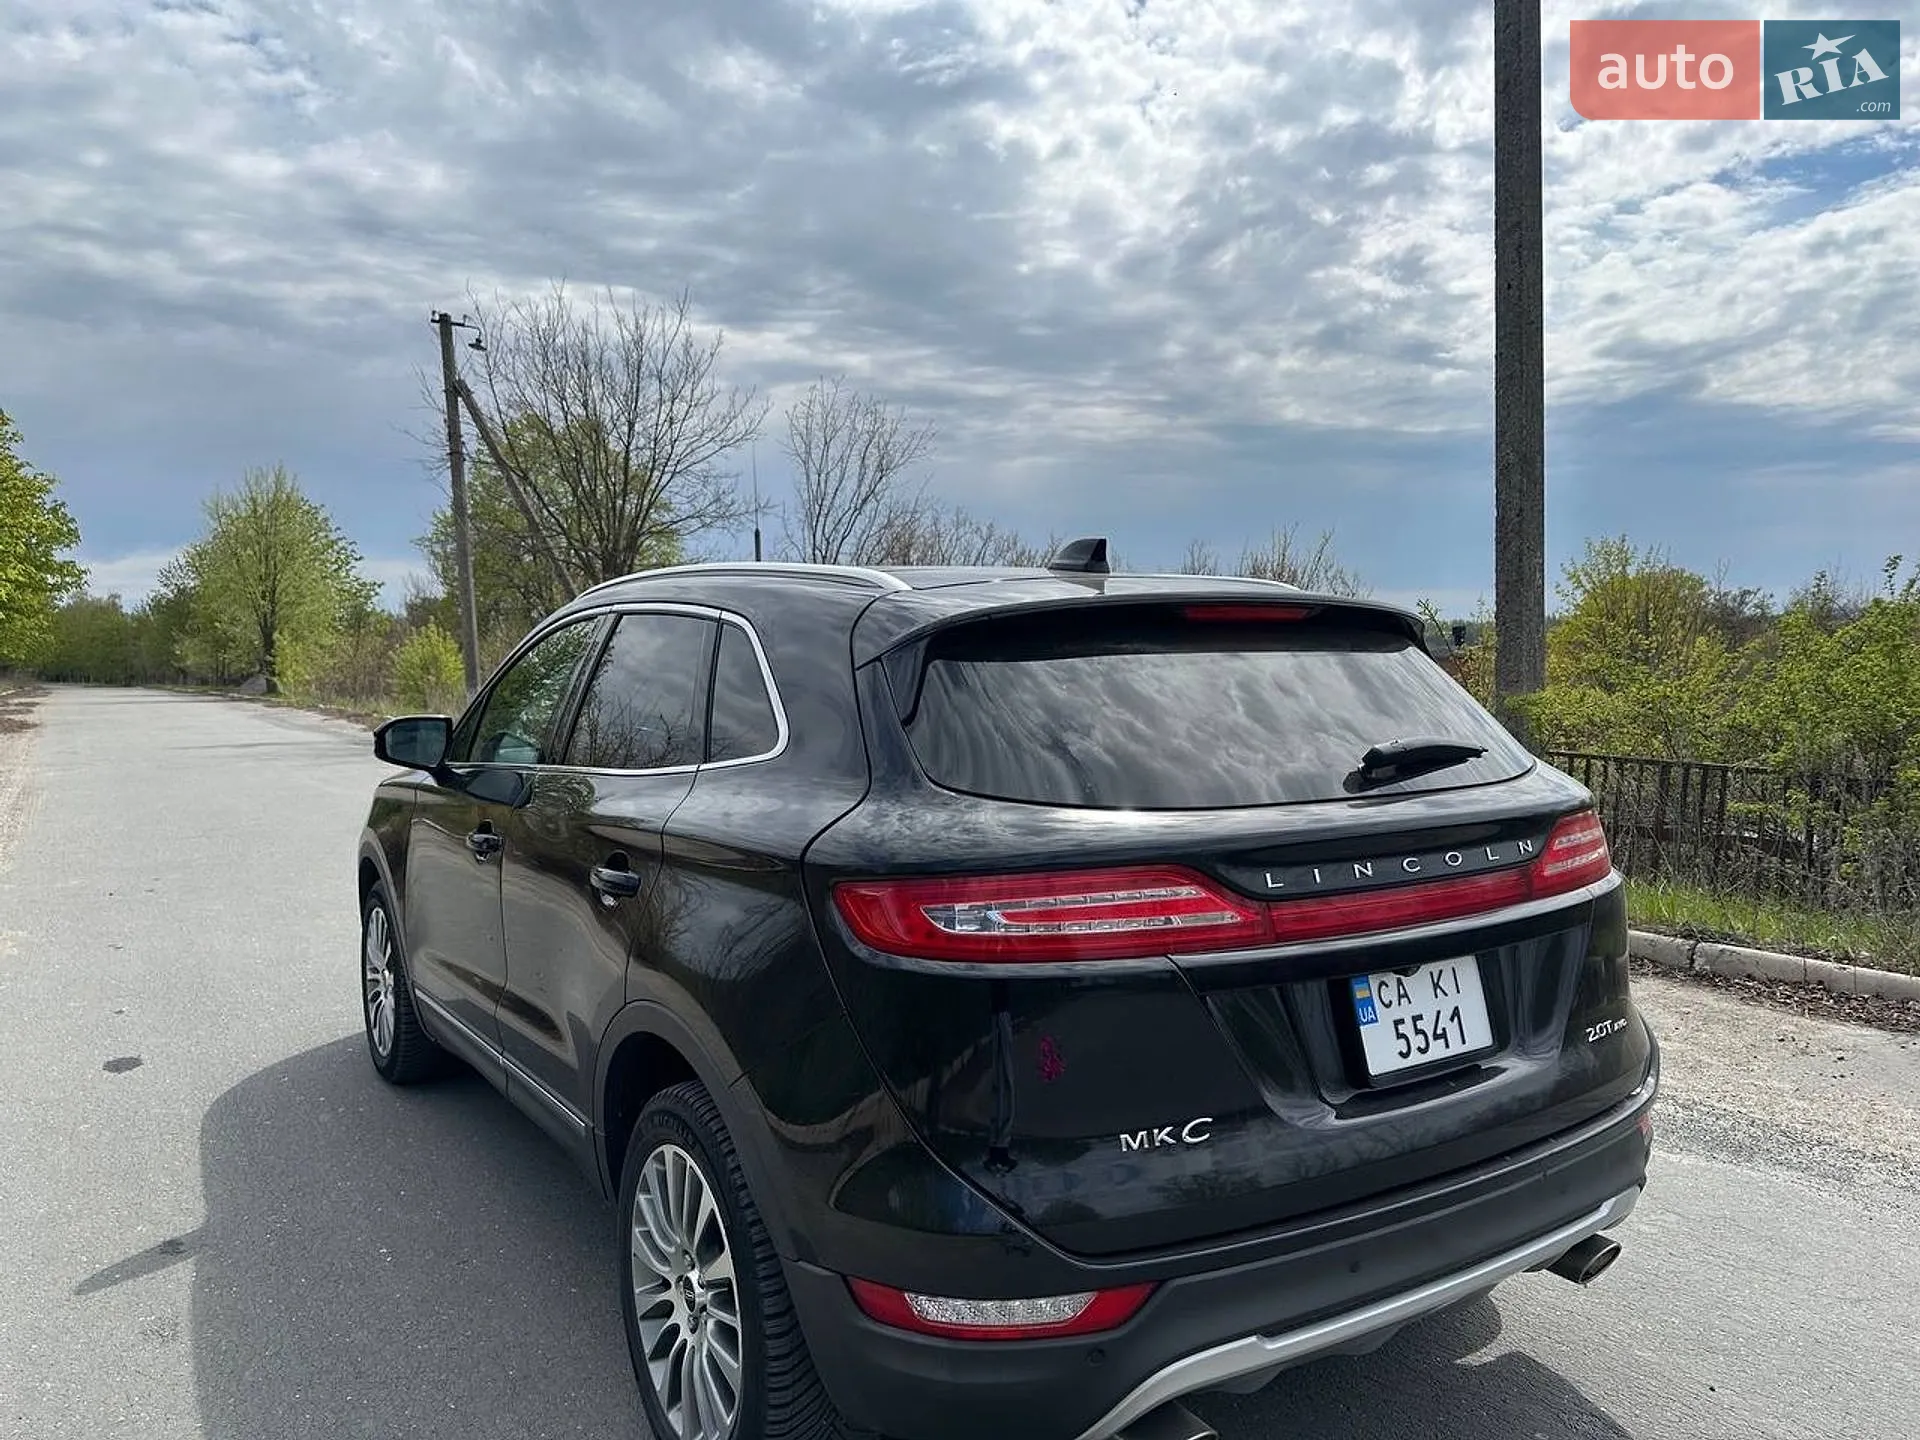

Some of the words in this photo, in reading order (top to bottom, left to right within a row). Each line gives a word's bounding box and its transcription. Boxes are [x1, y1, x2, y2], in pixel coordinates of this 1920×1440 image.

[1265, 840, 1533, 888] LINCOLN
[1377, 977, 1412, 1009] CA
[1429, 967, 1460, 999] KI
[1359, 1006, 1377, 1022] UA
[1393, 1006, 1466, 1059] 5541
[1119, 1117, 1213, 1151] MKC
